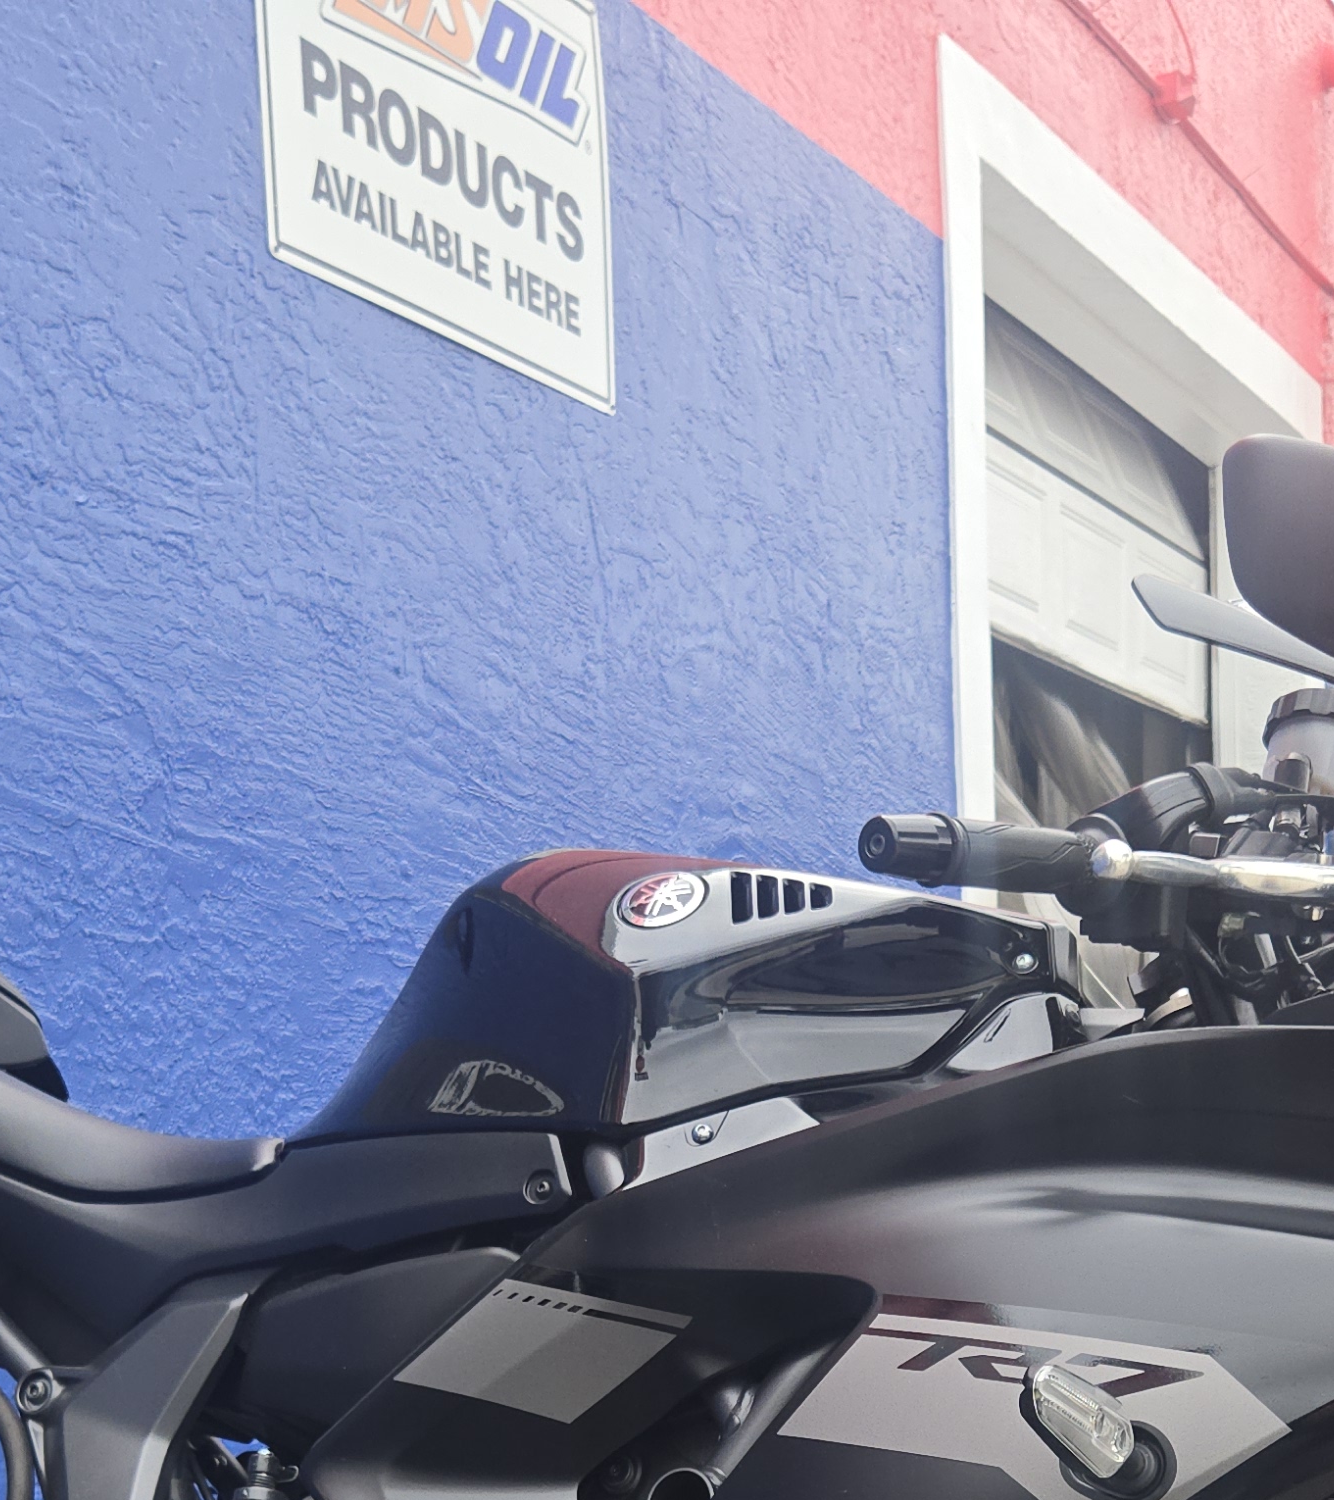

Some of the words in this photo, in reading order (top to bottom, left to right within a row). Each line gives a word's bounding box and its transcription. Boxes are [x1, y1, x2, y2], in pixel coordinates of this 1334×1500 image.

[299, 36, 584, 262] PRODUCTS
[311, 159, 492, 290] AVAILABLE
[503, 258, 581, 337] HERE
